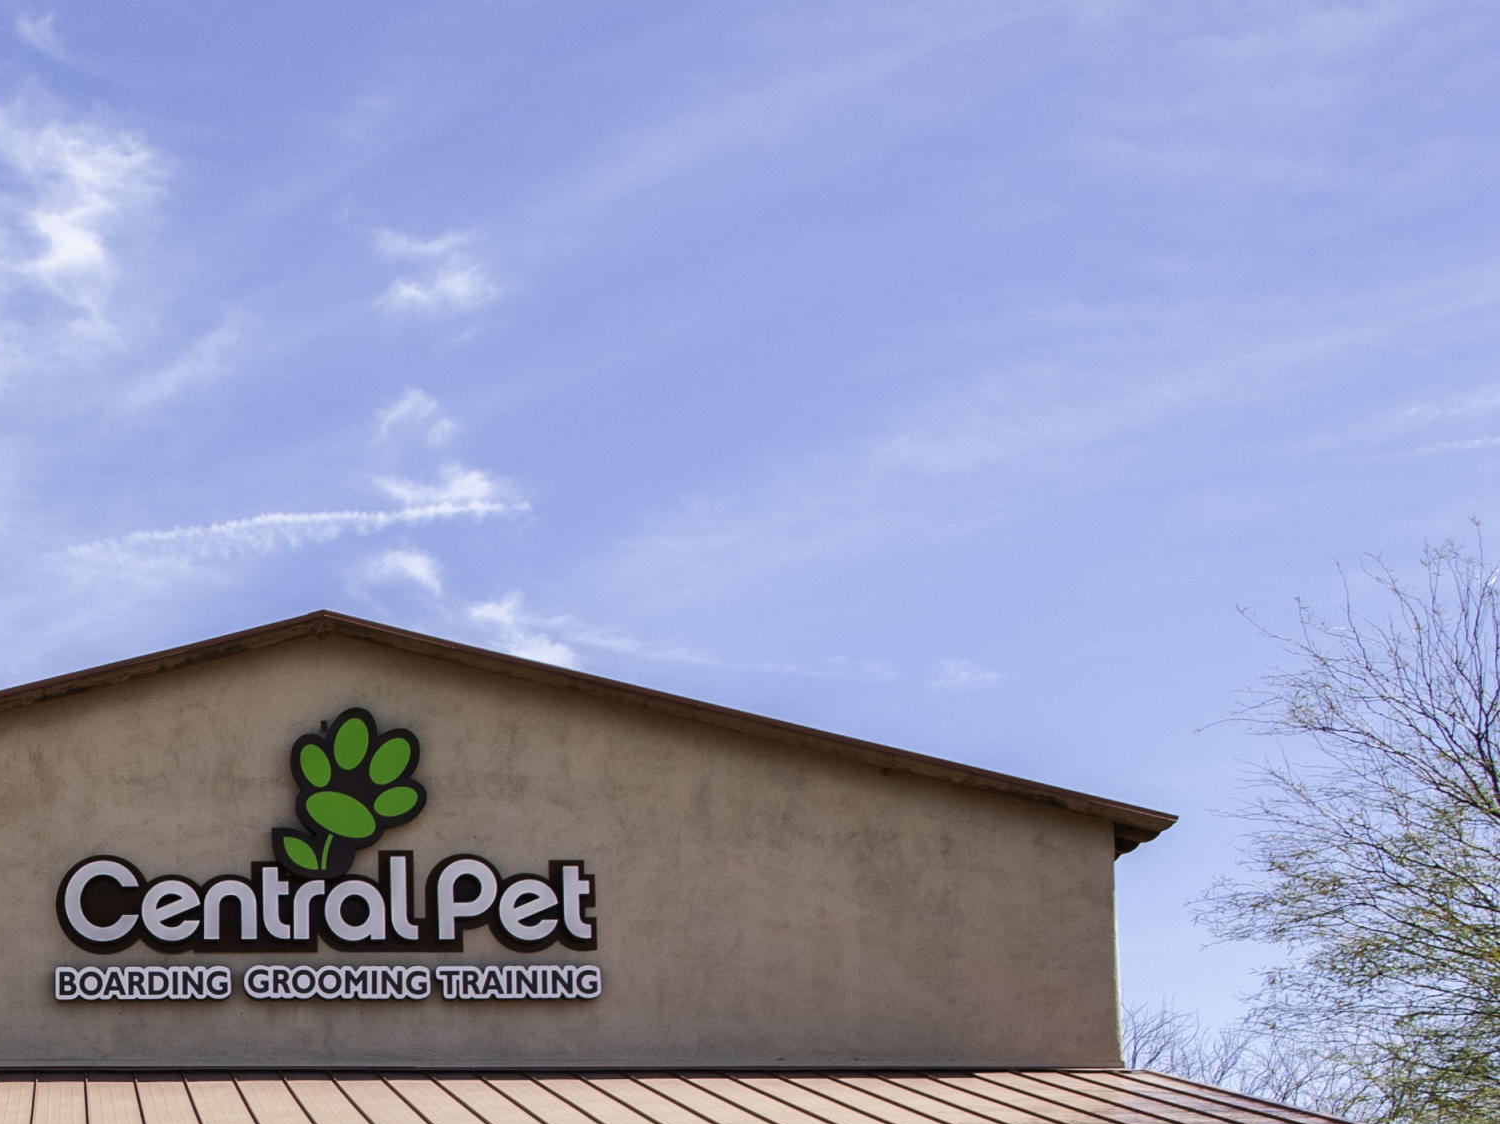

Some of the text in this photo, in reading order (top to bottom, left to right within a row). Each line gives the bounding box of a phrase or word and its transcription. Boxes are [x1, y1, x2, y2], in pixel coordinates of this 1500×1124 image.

[63, 855, 594, 943] Central Pet
[57, 967, 599, 998] BOARDING GROOMING TRAINING
